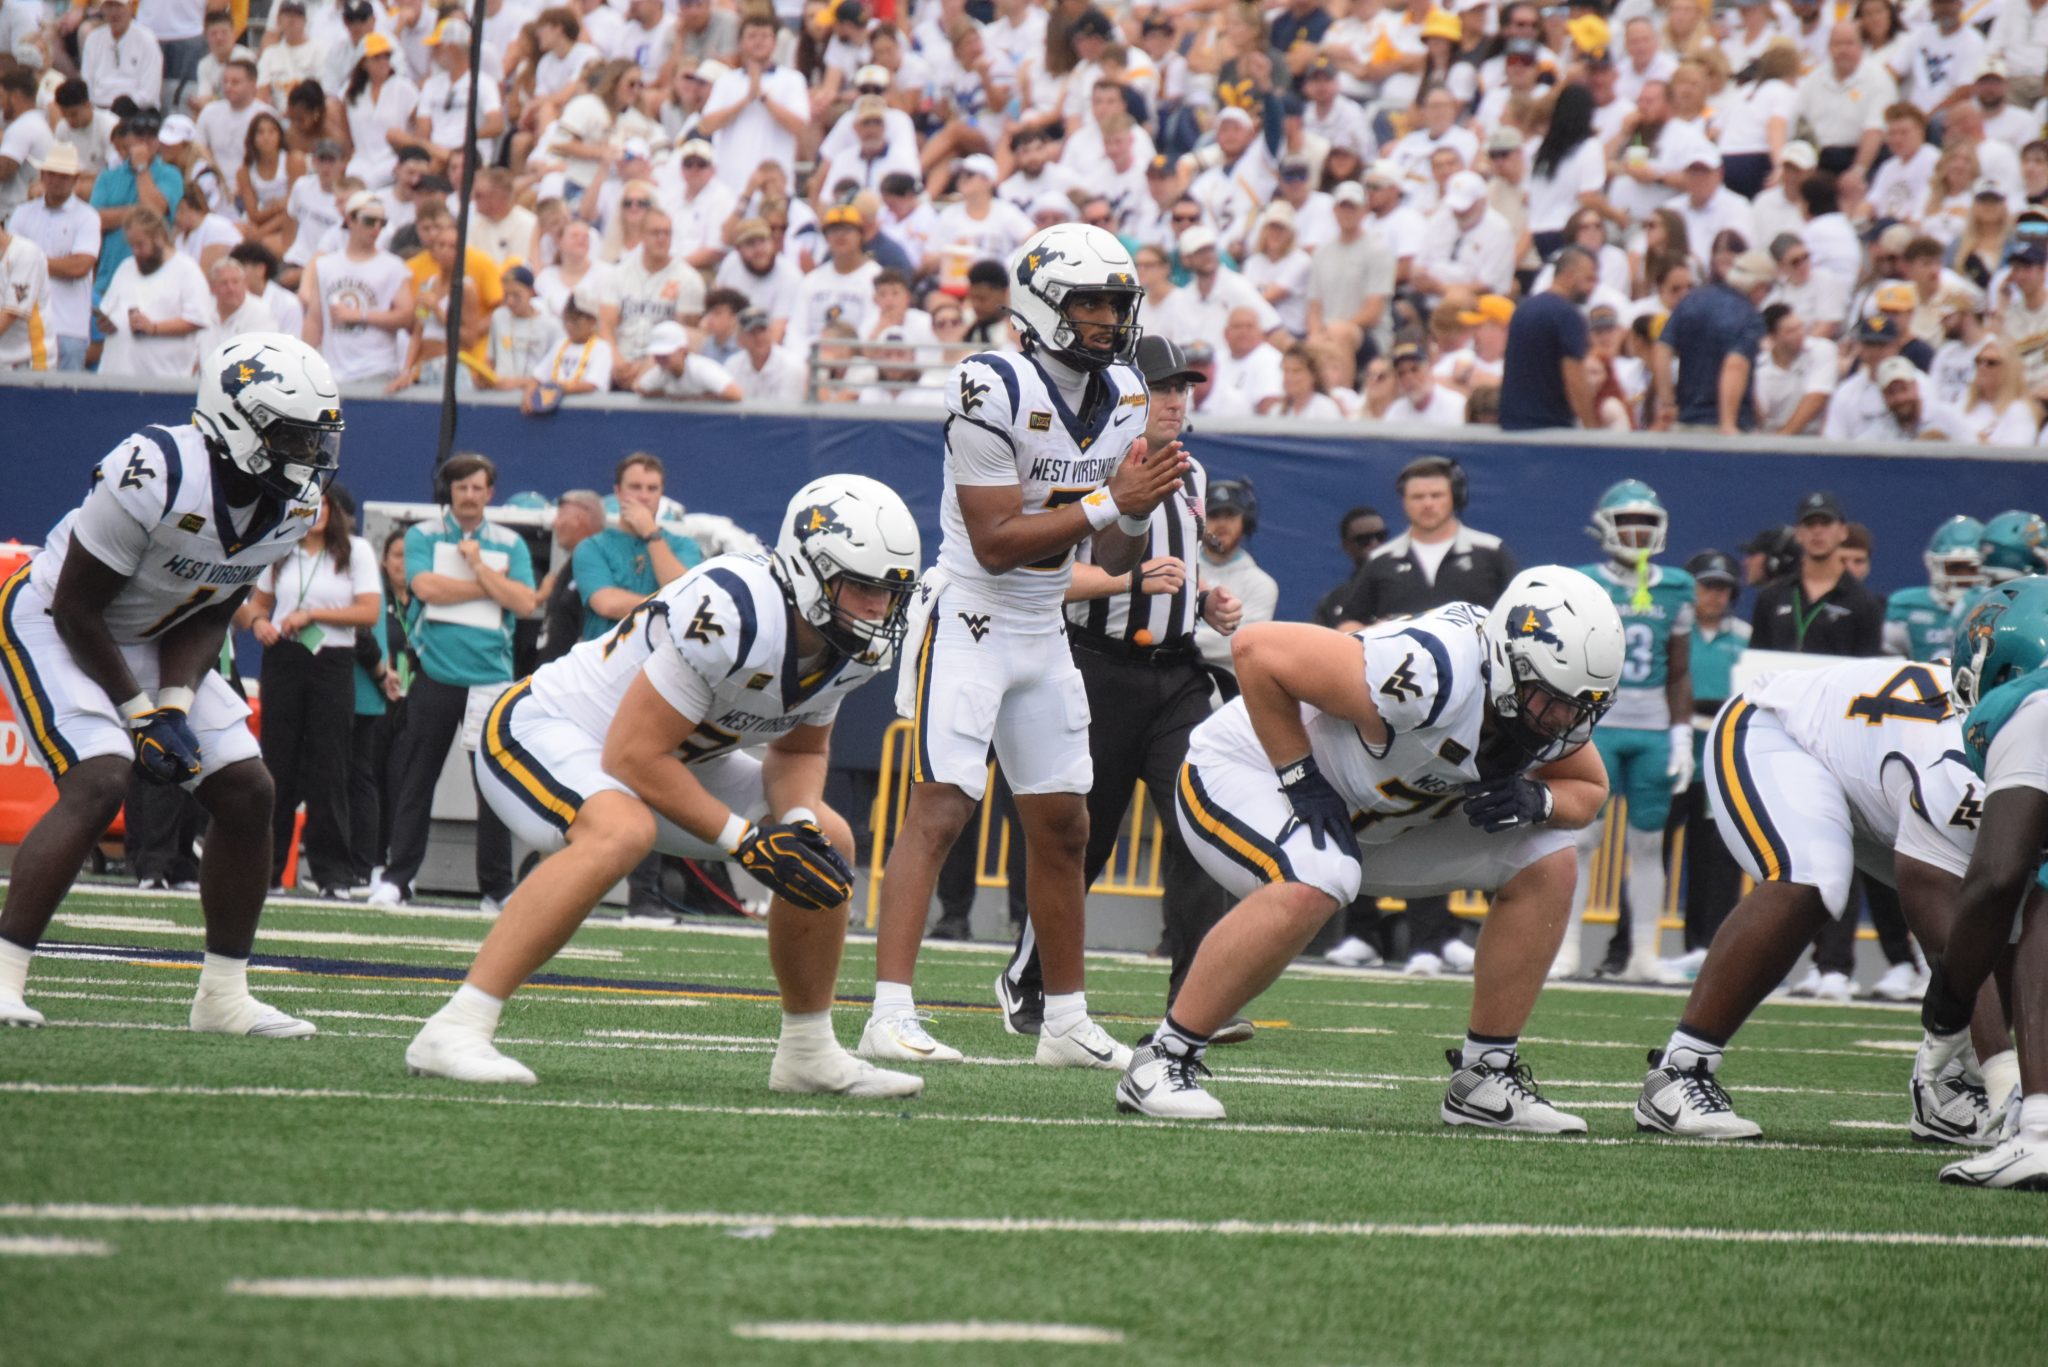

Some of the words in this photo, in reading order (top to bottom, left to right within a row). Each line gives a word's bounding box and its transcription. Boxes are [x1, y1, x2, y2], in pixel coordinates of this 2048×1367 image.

[1029, 457, 1071, 483] WEST
[163, 554, 210, 582] WEST
[1281, 762, 1306, 787] NIKE
